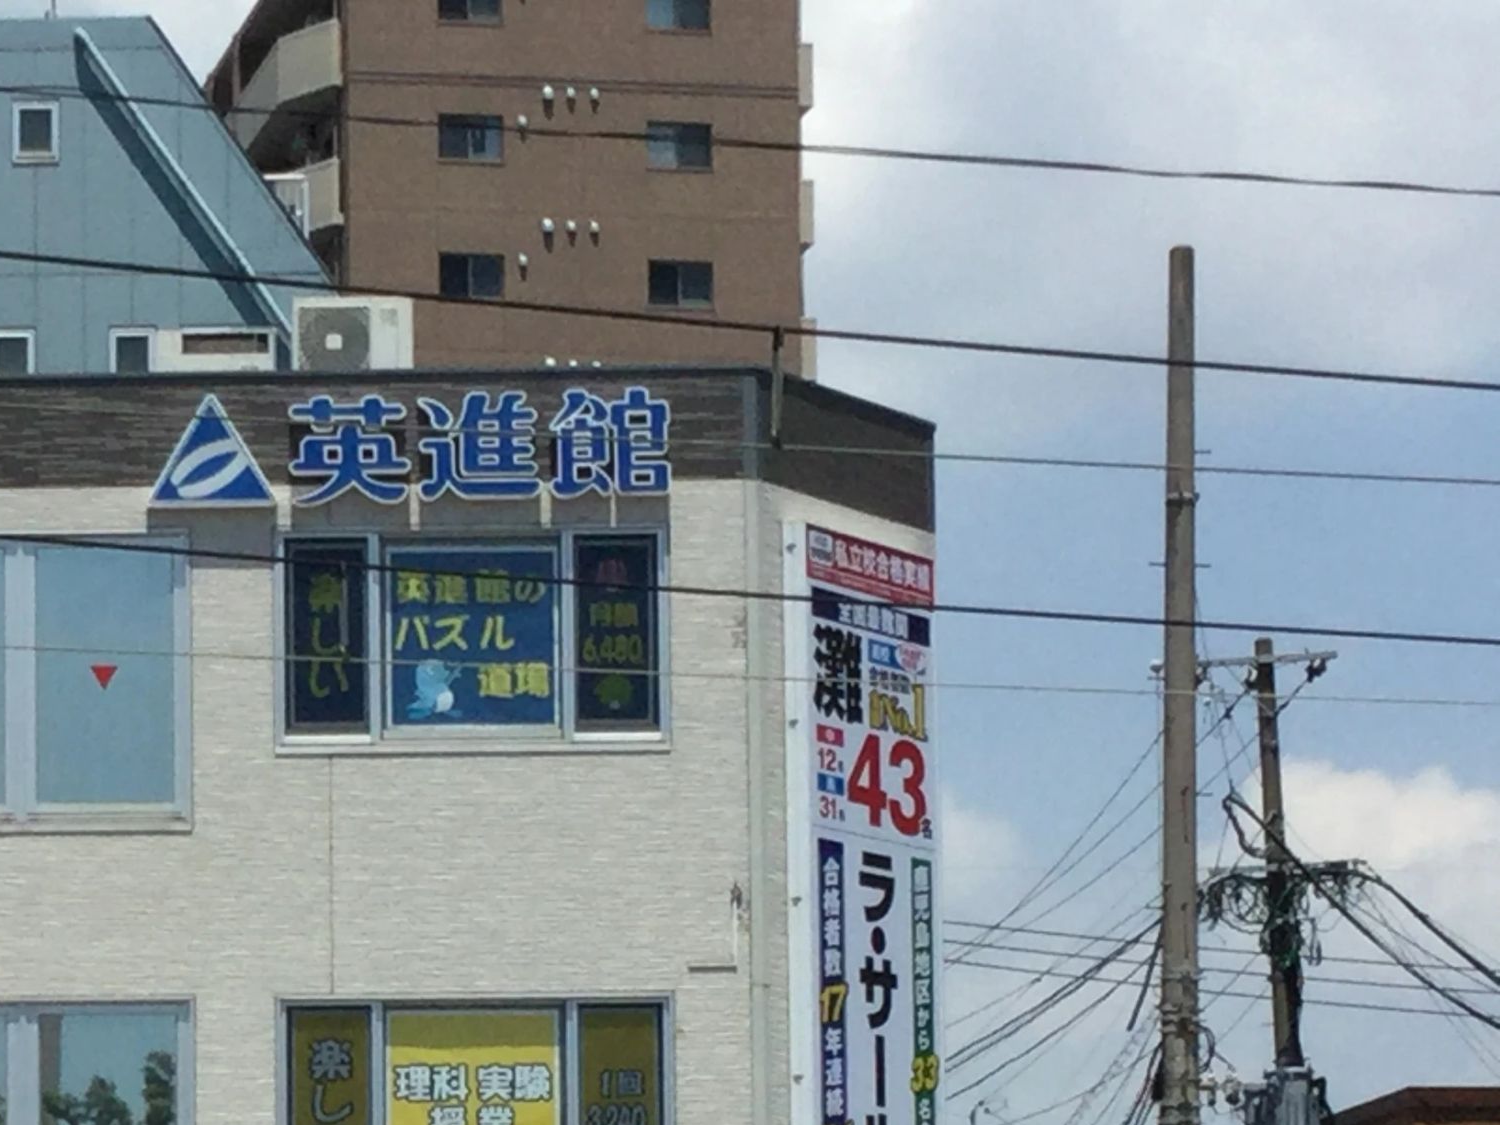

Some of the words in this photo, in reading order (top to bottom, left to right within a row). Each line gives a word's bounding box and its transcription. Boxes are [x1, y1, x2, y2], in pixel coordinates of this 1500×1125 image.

[288, 386, 672, 504] 英進館
[396, 568, 549, 605] 英進館の
[477, 661, 551, 699] 道場
[598, 1068, 644, 1098] 1回
